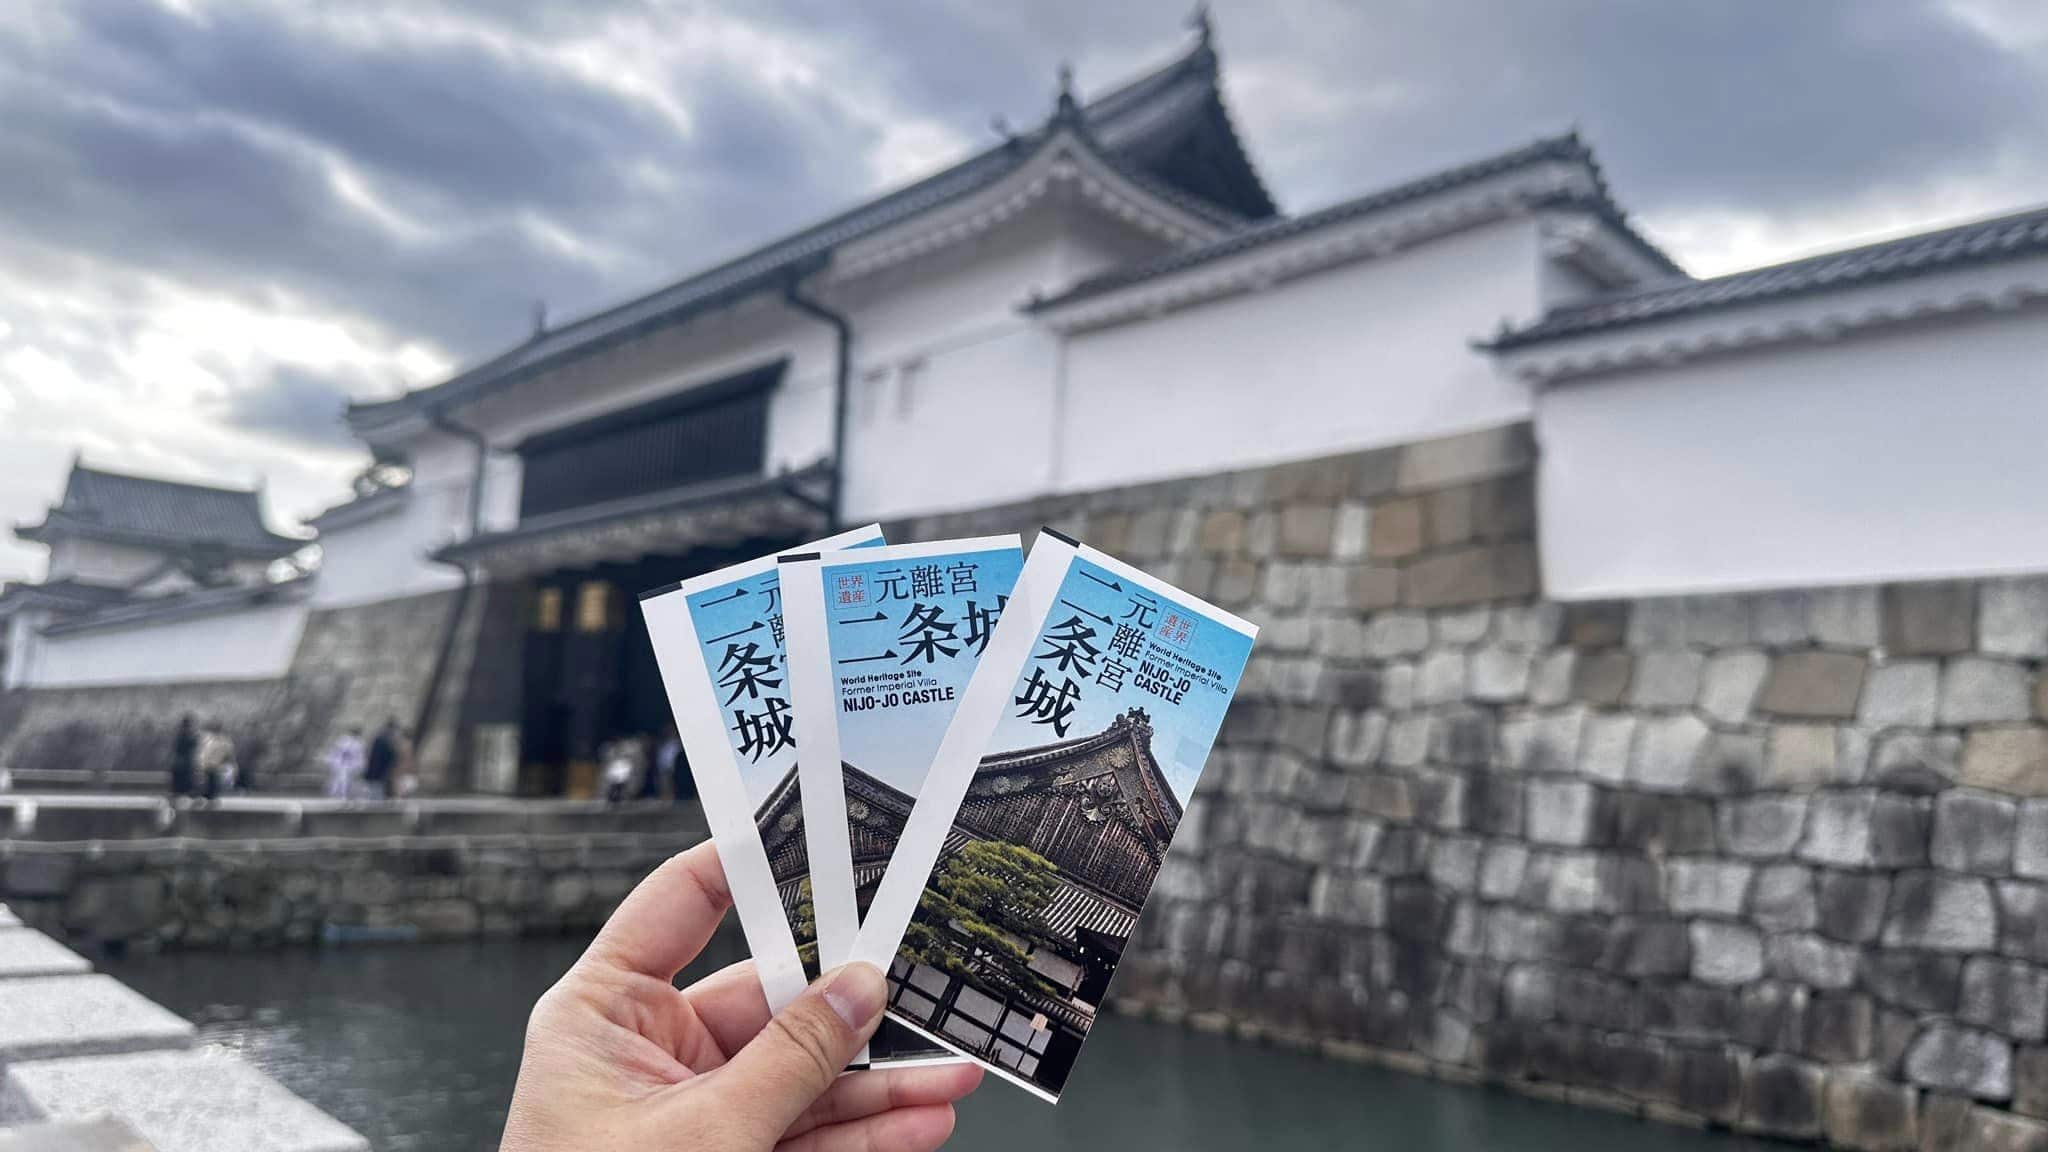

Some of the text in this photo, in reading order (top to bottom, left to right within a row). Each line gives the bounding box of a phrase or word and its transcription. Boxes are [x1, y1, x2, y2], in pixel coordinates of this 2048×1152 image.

[838, 575, 864, 590] 世界
[873, 560, 979, 604] 元離宮
[1014, 569, 1123, 738] 二条城
[1095, 592, 1158, 694] 元離宮
[1148, 641, 1223, 681] World Heritage Site
[700, 587, 796, 765] 二条城
[840, 669, 922, 686] World Heritage Site
[841, 677, 938, 696] Former Imperial Villa
[1133, 673, 1184, 706] CASTLE
[1139, 659, 1191, 693] NIJO-JO
[1144, 650, 1229, 695] Former Imperial Villa
[843, 686, 955, 712] NIJO-JO CASTLE
